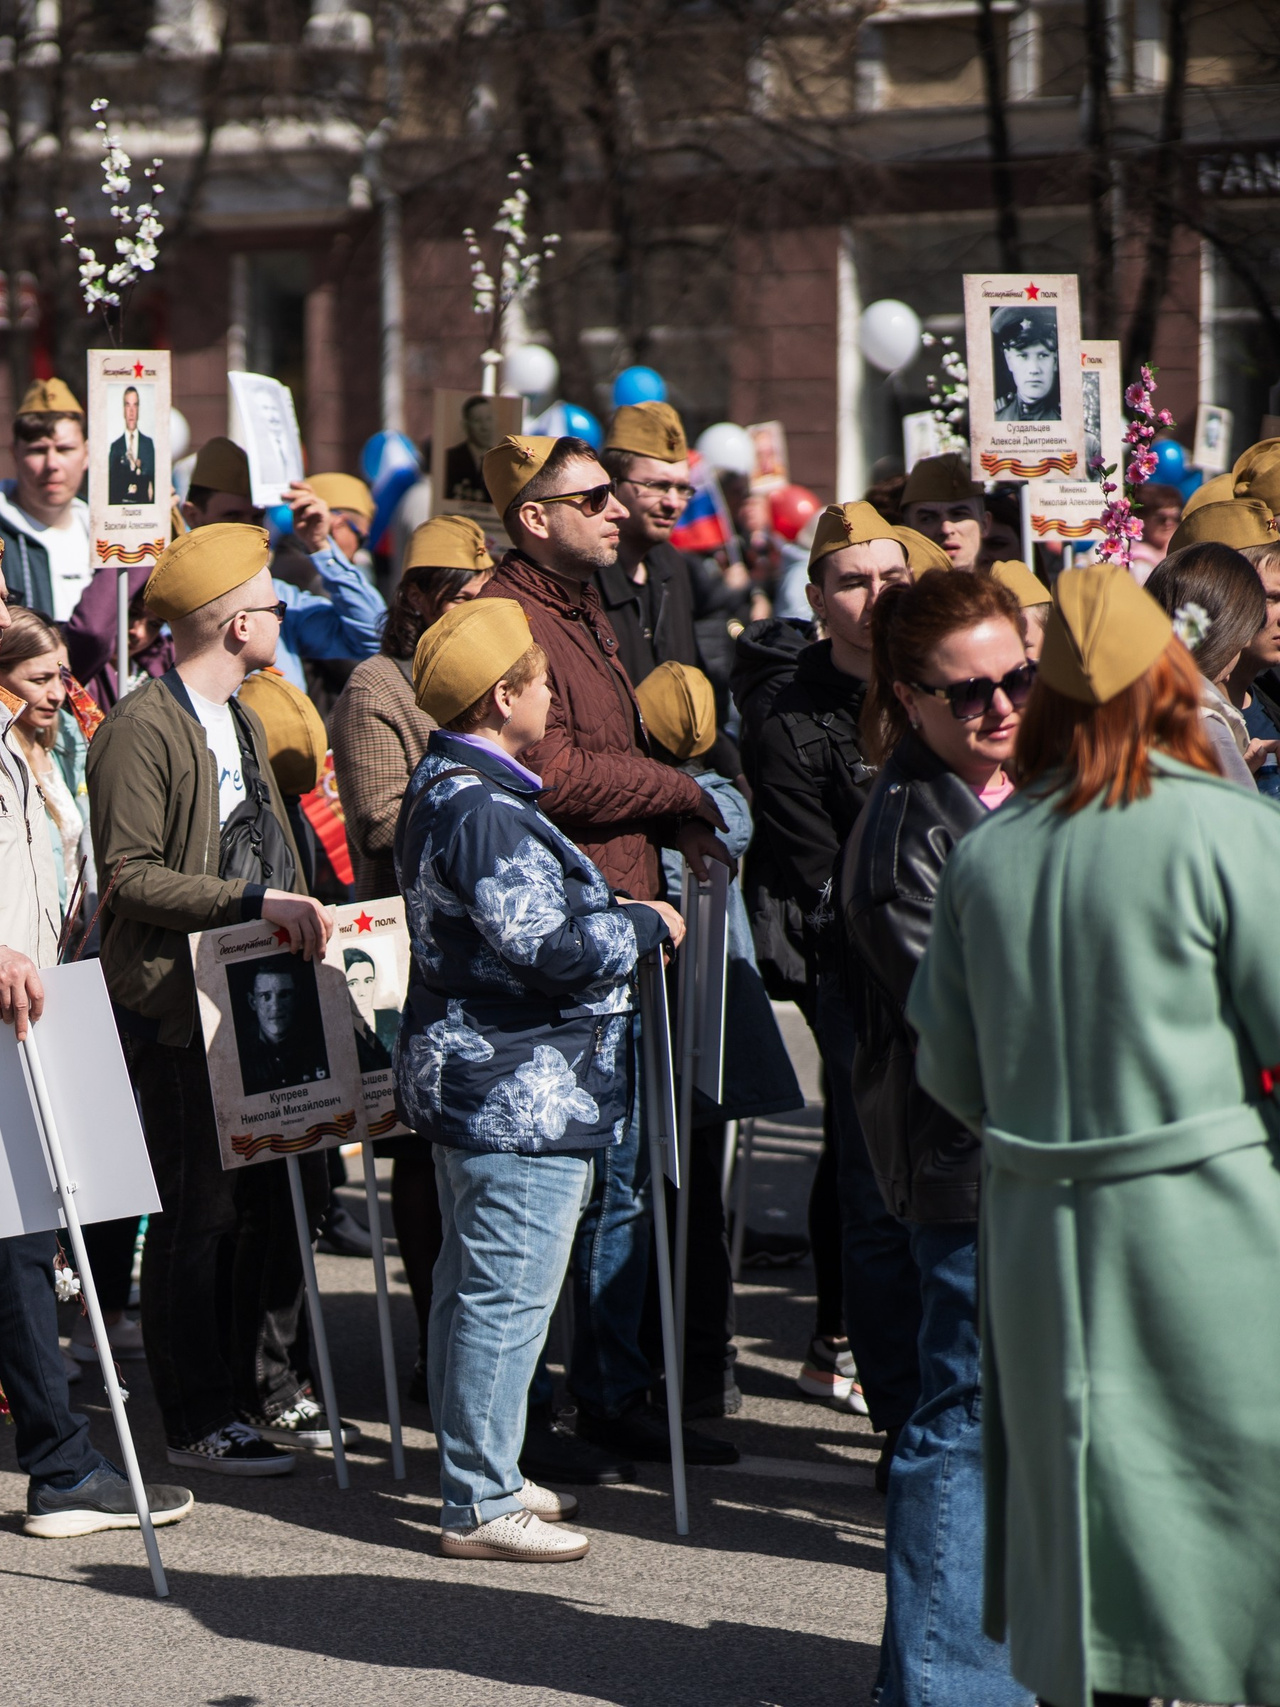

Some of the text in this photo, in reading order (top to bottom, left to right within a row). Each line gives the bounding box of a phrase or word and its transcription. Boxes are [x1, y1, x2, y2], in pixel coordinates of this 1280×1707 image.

[1006, 423, 1051, 435] Суздальцев
[990, 435, 1067, 446] Алексей Дмитриевич
[1039, 497, 1068, 507] Николай
[374, 917, 397, 928] полк
[218, 933, 272, 956] бессмертный
[361, 1073, 388, 1086] ышев
[269, 1087, 309, 1105] Купреев
[362, 1087, 392, 1101] ндрее
[240, 1107, 282, 1126] Николай
[282, 1095, 342, 1117] Михайлович
